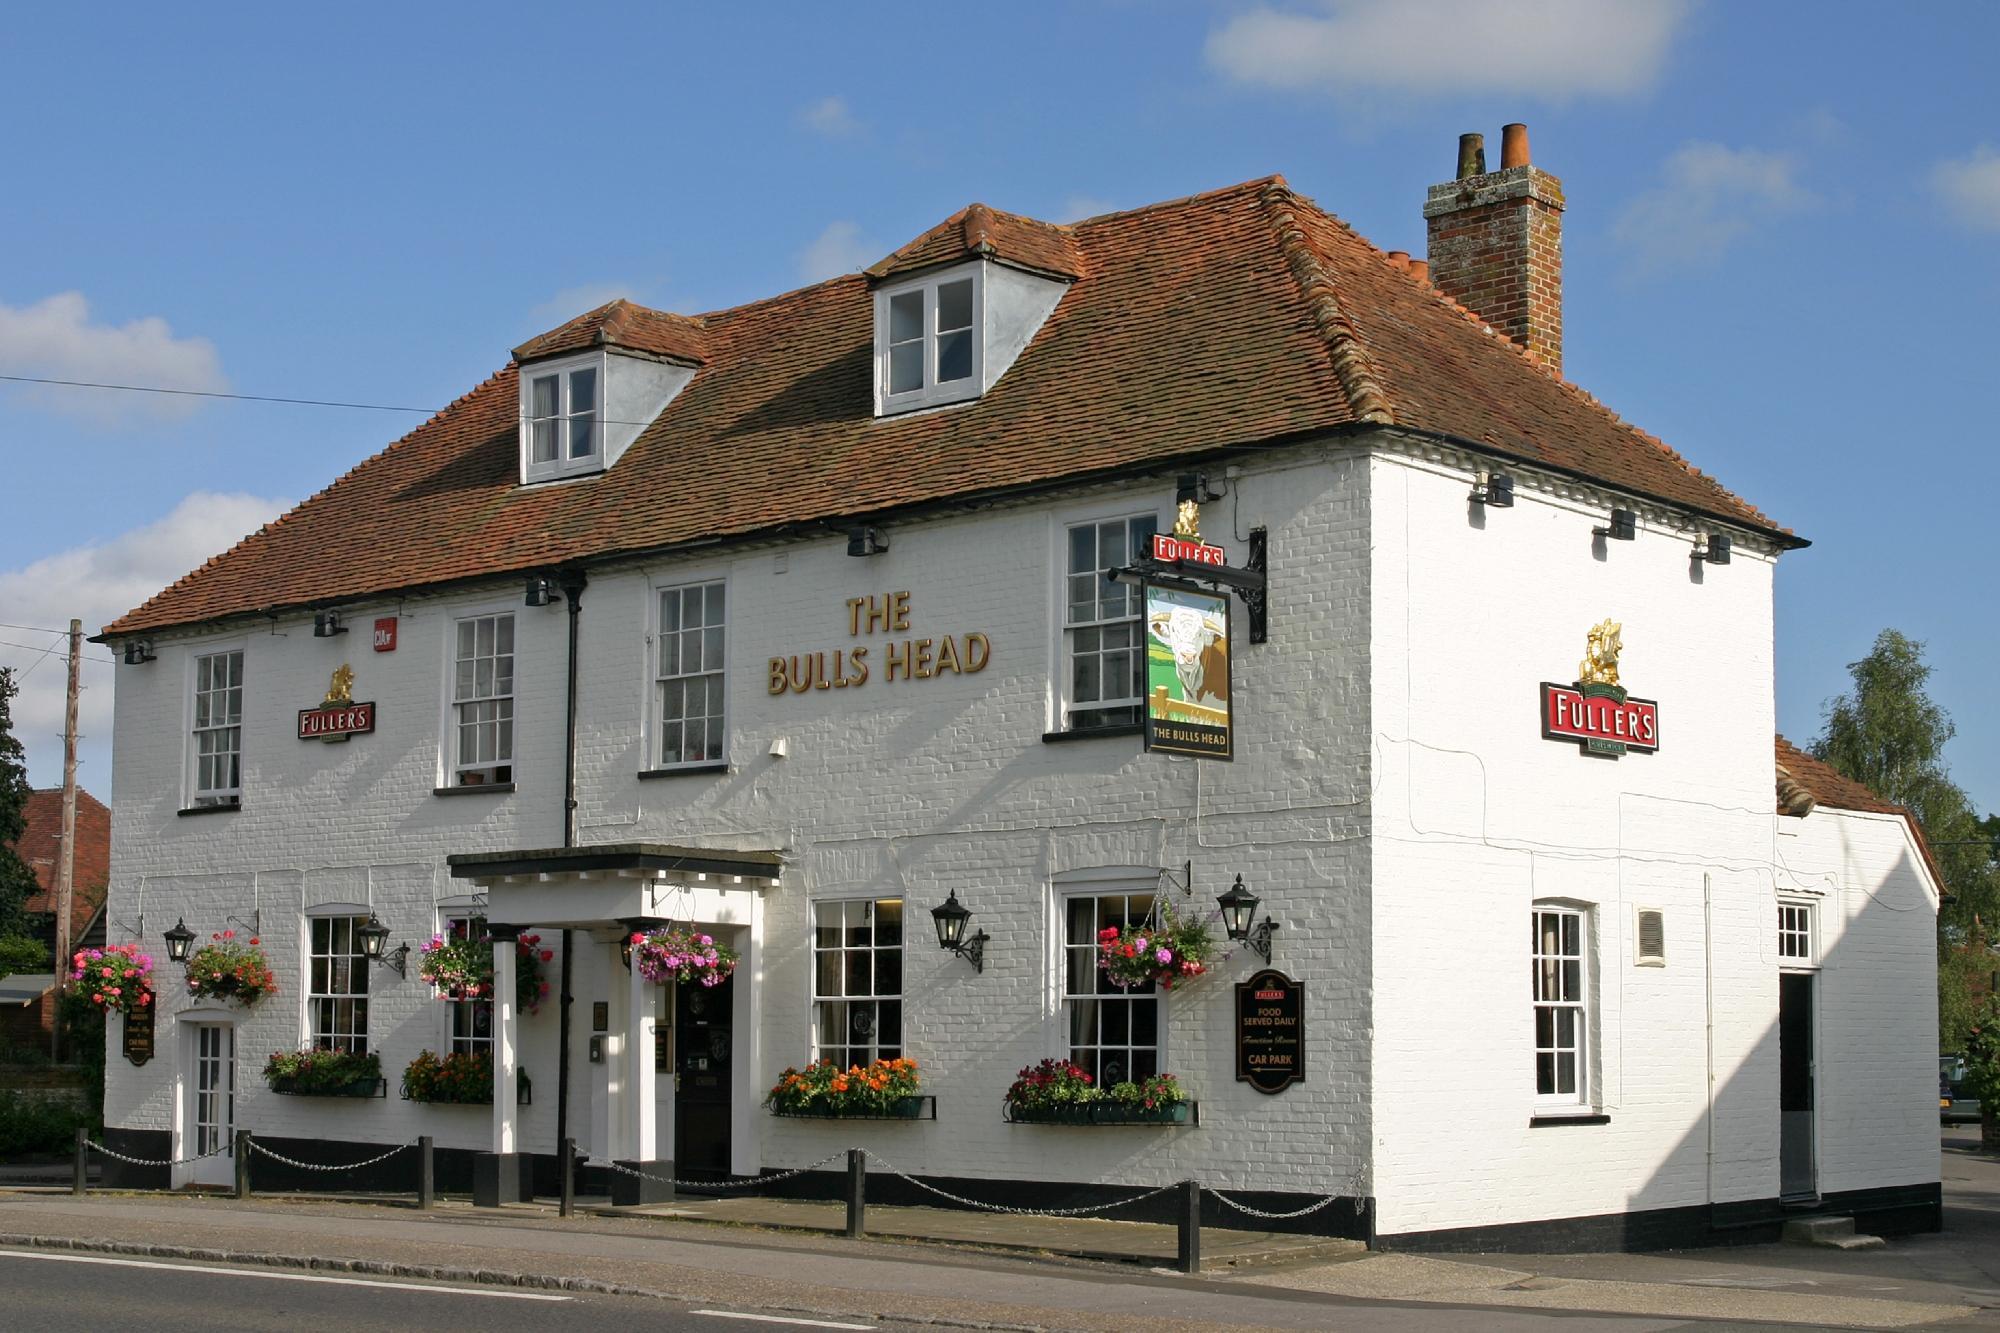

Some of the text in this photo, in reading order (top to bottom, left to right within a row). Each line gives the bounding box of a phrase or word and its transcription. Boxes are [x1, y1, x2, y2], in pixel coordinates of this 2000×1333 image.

[846, 591, 910, 635] THE
[768, 632, 990, 694] BULLS HEAD
[302, 709, 366, 733] FULLER'S
[1557, 693, 1653, 740] FULLER'S
[1153, 727, 1226, 745] THE BULLS HEAD
[1243, 1017, 1297, 1026] SERVED DAILY
[1258, 1008, 1282, 1017] FOOD
[1248, 1055, 1293, 1065] CAR PARK
